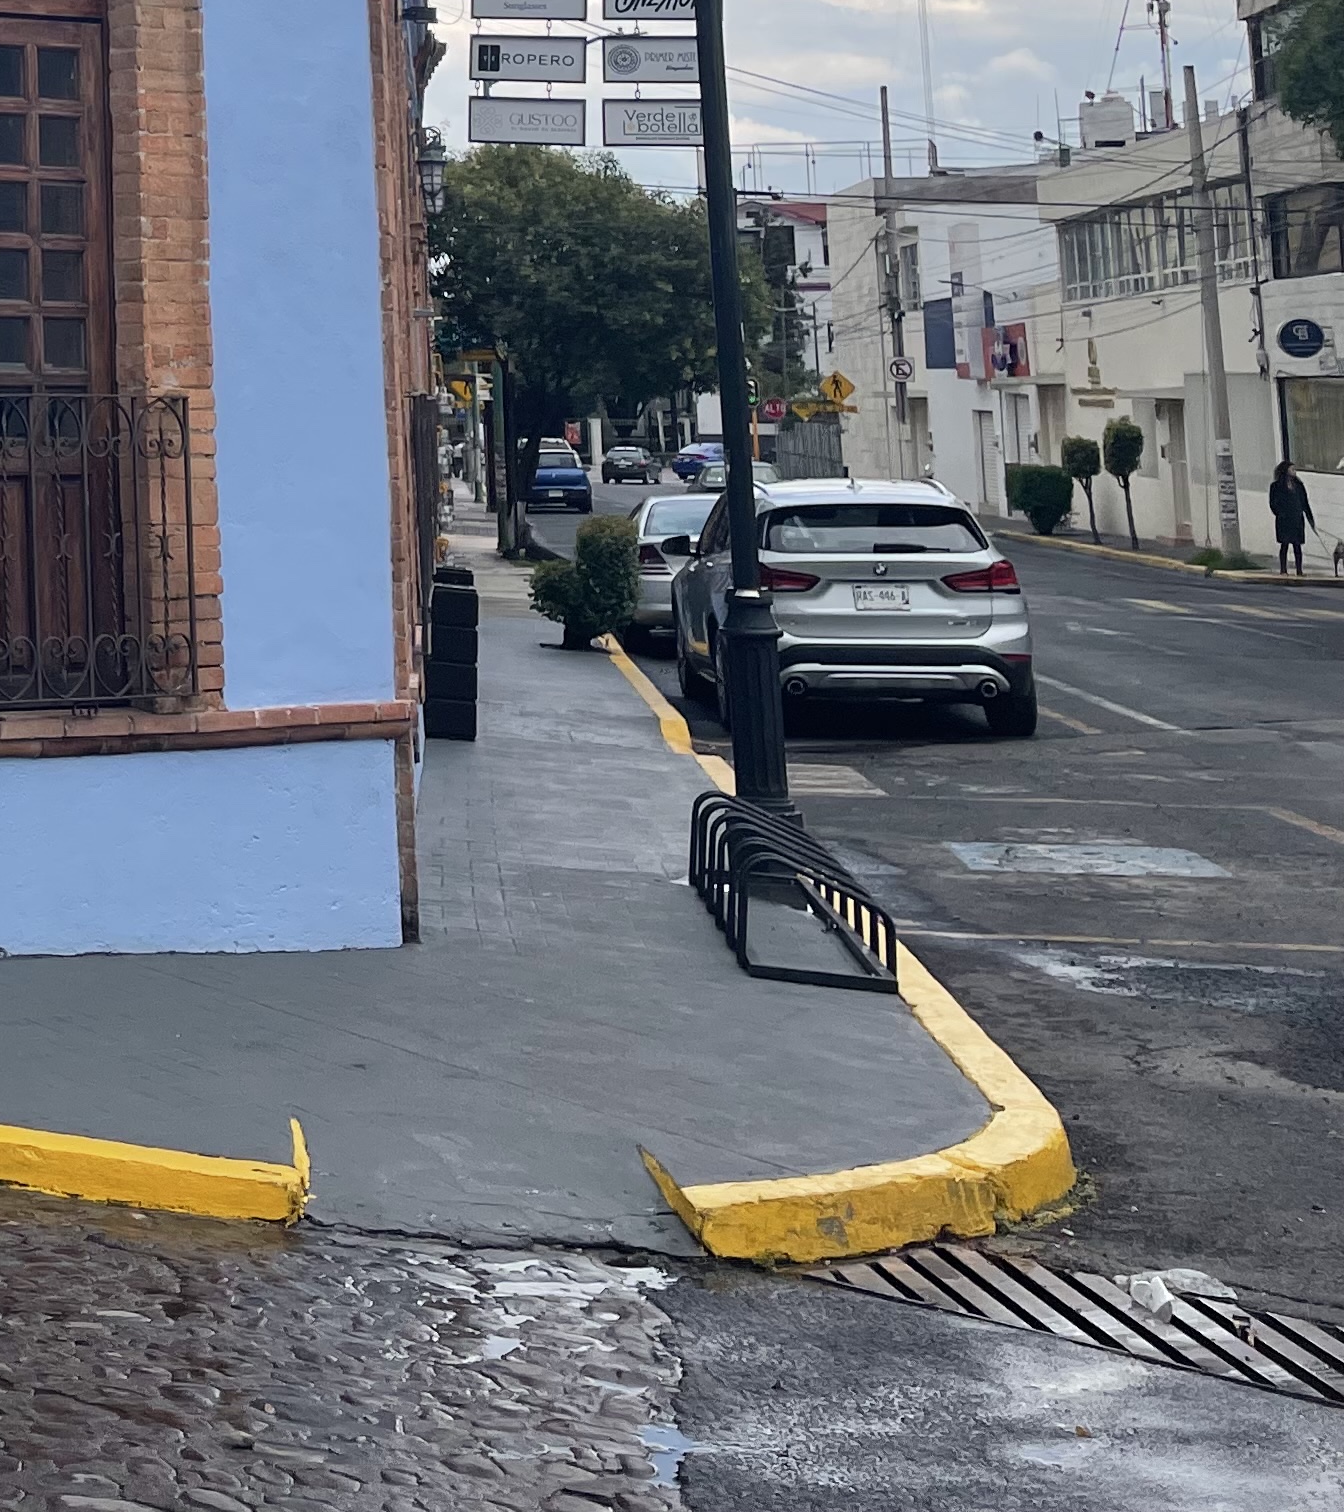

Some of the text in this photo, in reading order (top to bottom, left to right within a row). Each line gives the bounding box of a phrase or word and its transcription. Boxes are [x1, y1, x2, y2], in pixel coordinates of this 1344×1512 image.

[501, 53, 575, 67] ROPERO
[508, 112, 578, 128] GUSTOO
[624, 107, 676, 122] Verde
[637, 112, 699, 133] botella
